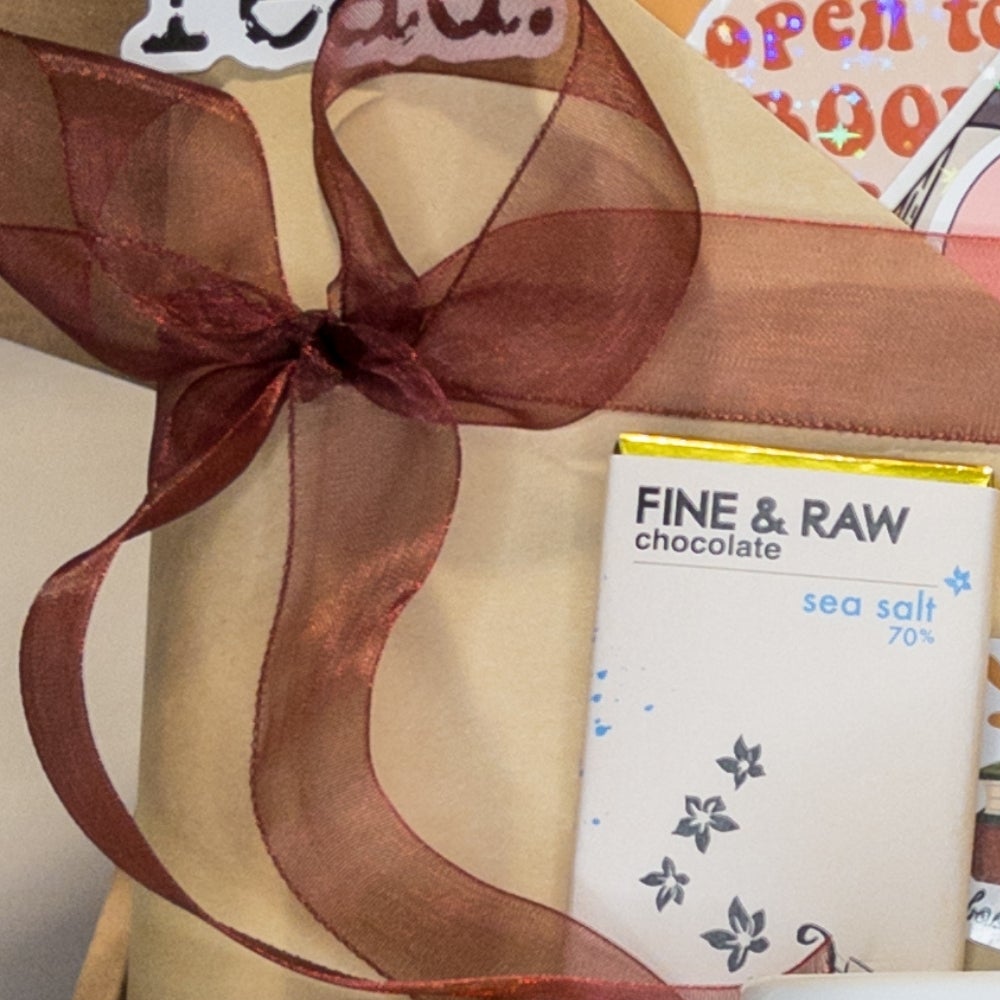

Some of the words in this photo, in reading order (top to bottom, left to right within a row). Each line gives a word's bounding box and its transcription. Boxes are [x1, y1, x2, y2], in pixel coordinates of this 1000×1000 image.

[706, 0, 913, 71] open
[635, 485, 739, 531] FINE
[751, 496, 789, 535] &
[800, 498, 911, 545] RAW
[634, 528, 782, 560] chocolate
[803, 591, 862, 617] sea
[876, 589, 937, 622] salt
[887, 626, 935, 647] 70%
